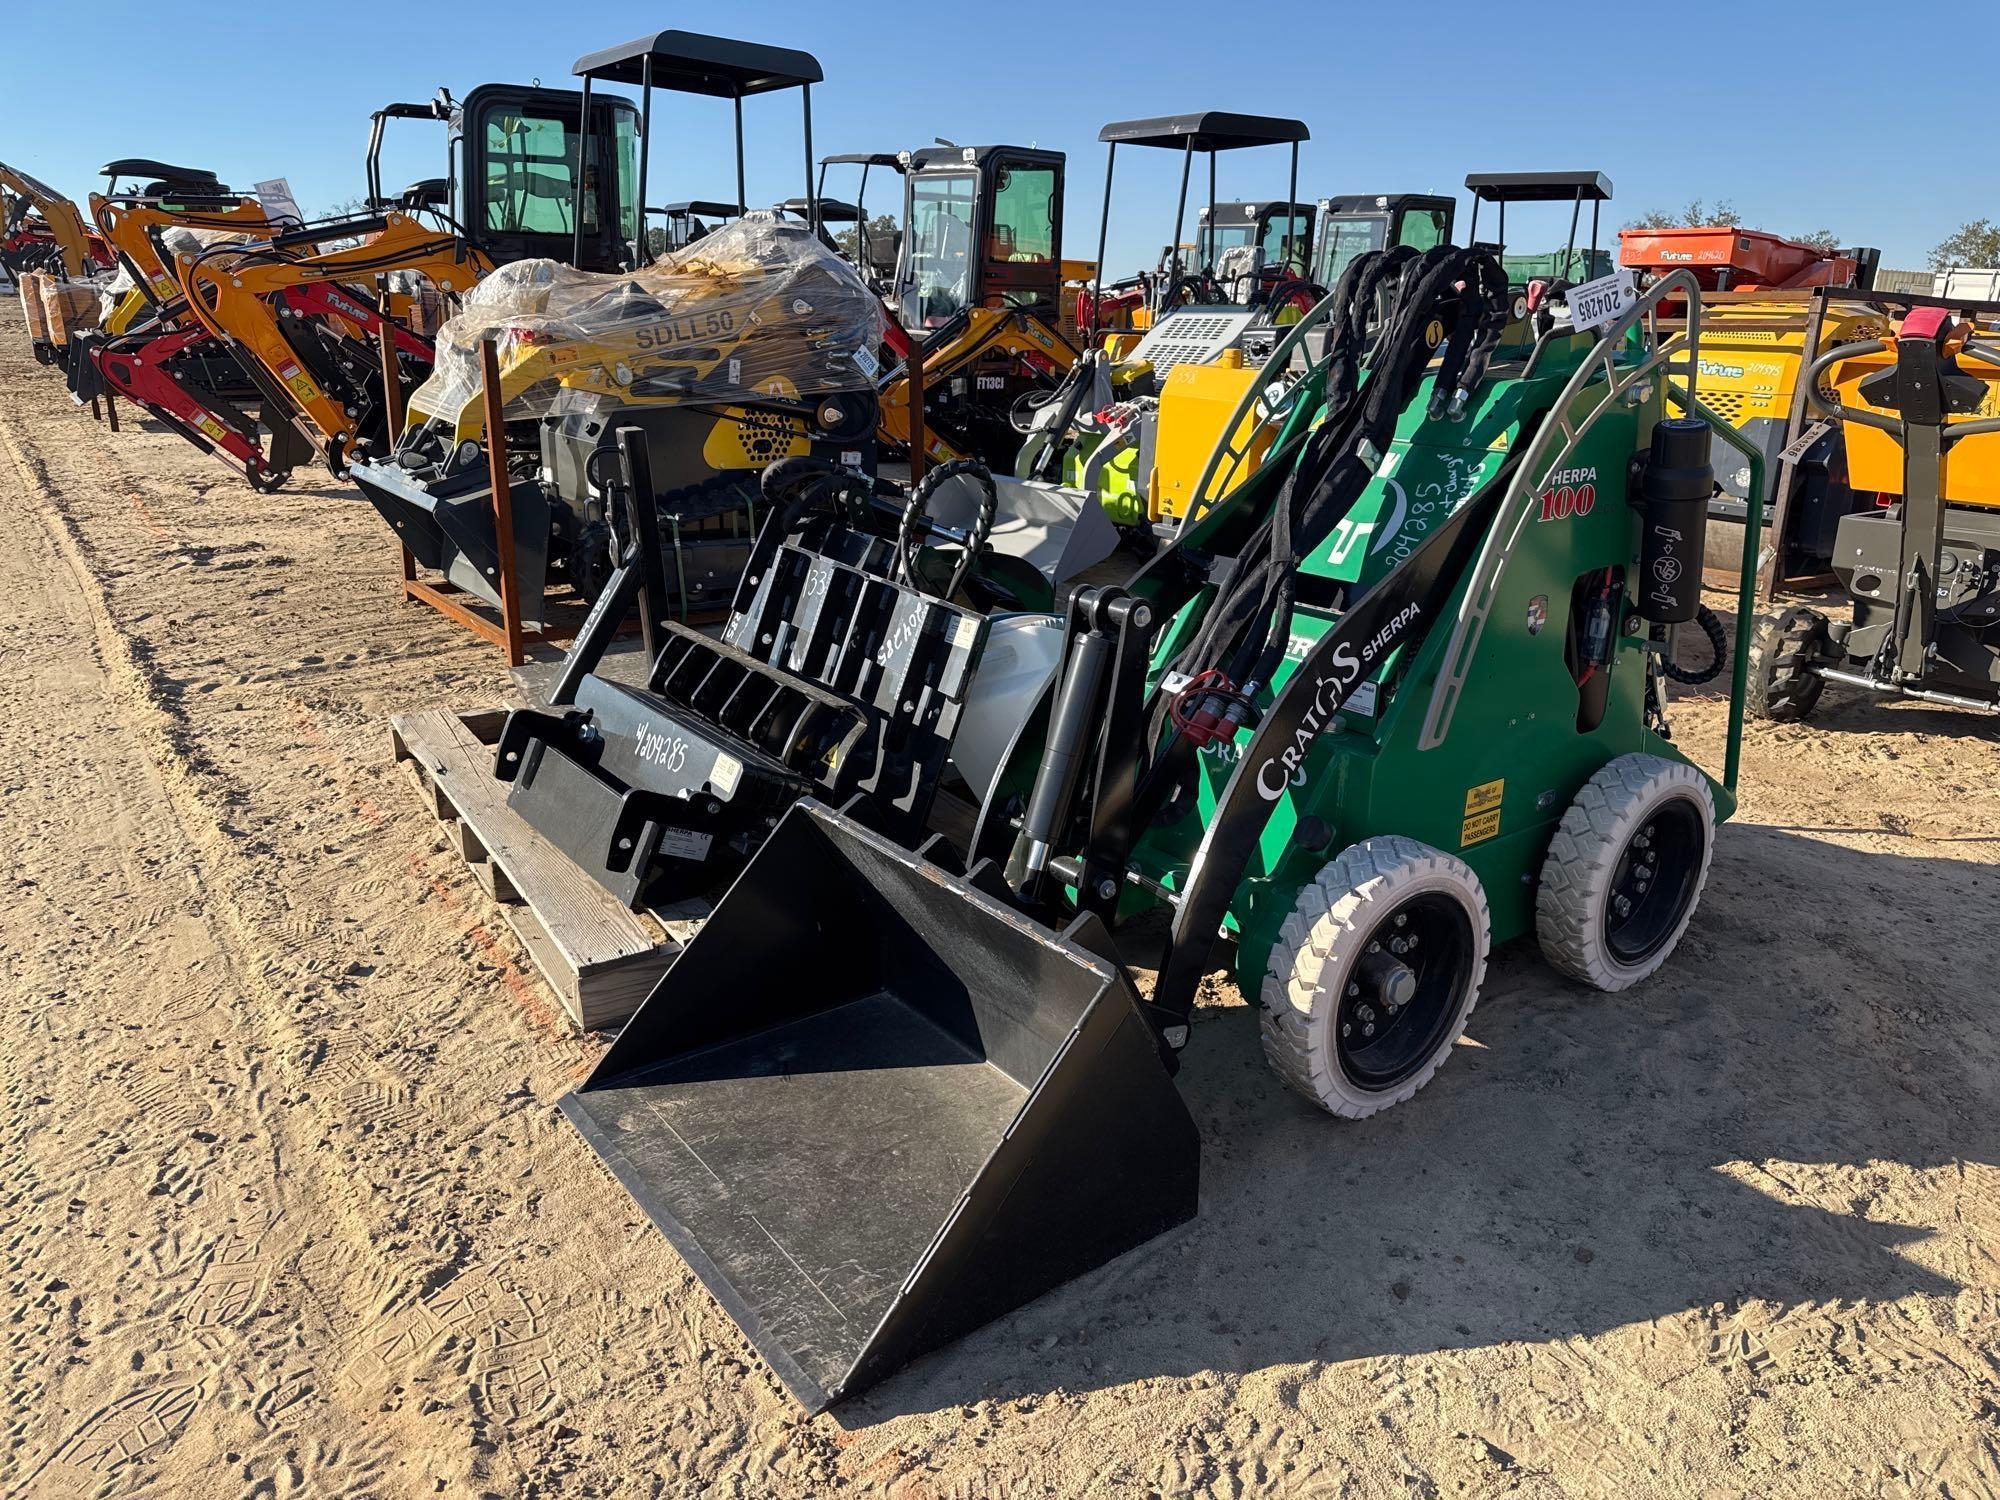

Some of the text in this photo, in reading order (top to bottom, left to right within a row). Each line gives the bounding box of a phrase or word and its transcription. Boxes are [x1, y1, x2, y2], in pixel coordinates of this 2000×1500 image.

[1660, 250, 1693, 261] Future
[326, 292, 369, 322] Future
[1578, 290, 1621, 322] 204285
[635, 311, 734, 349] SDLL50
[1698, 359, 1744, 378] Future
[1544, 466, 1597, 485] HERPA
[1537, 483, 1596, 523] 100
[802, 569, 828, 598] 133
[1362, 601, 1421, 662] SHERPA
[1463, 813, 1499, 832] DO NOT CARRY
[1464, 825, 1496, 841] PASSENGERS
